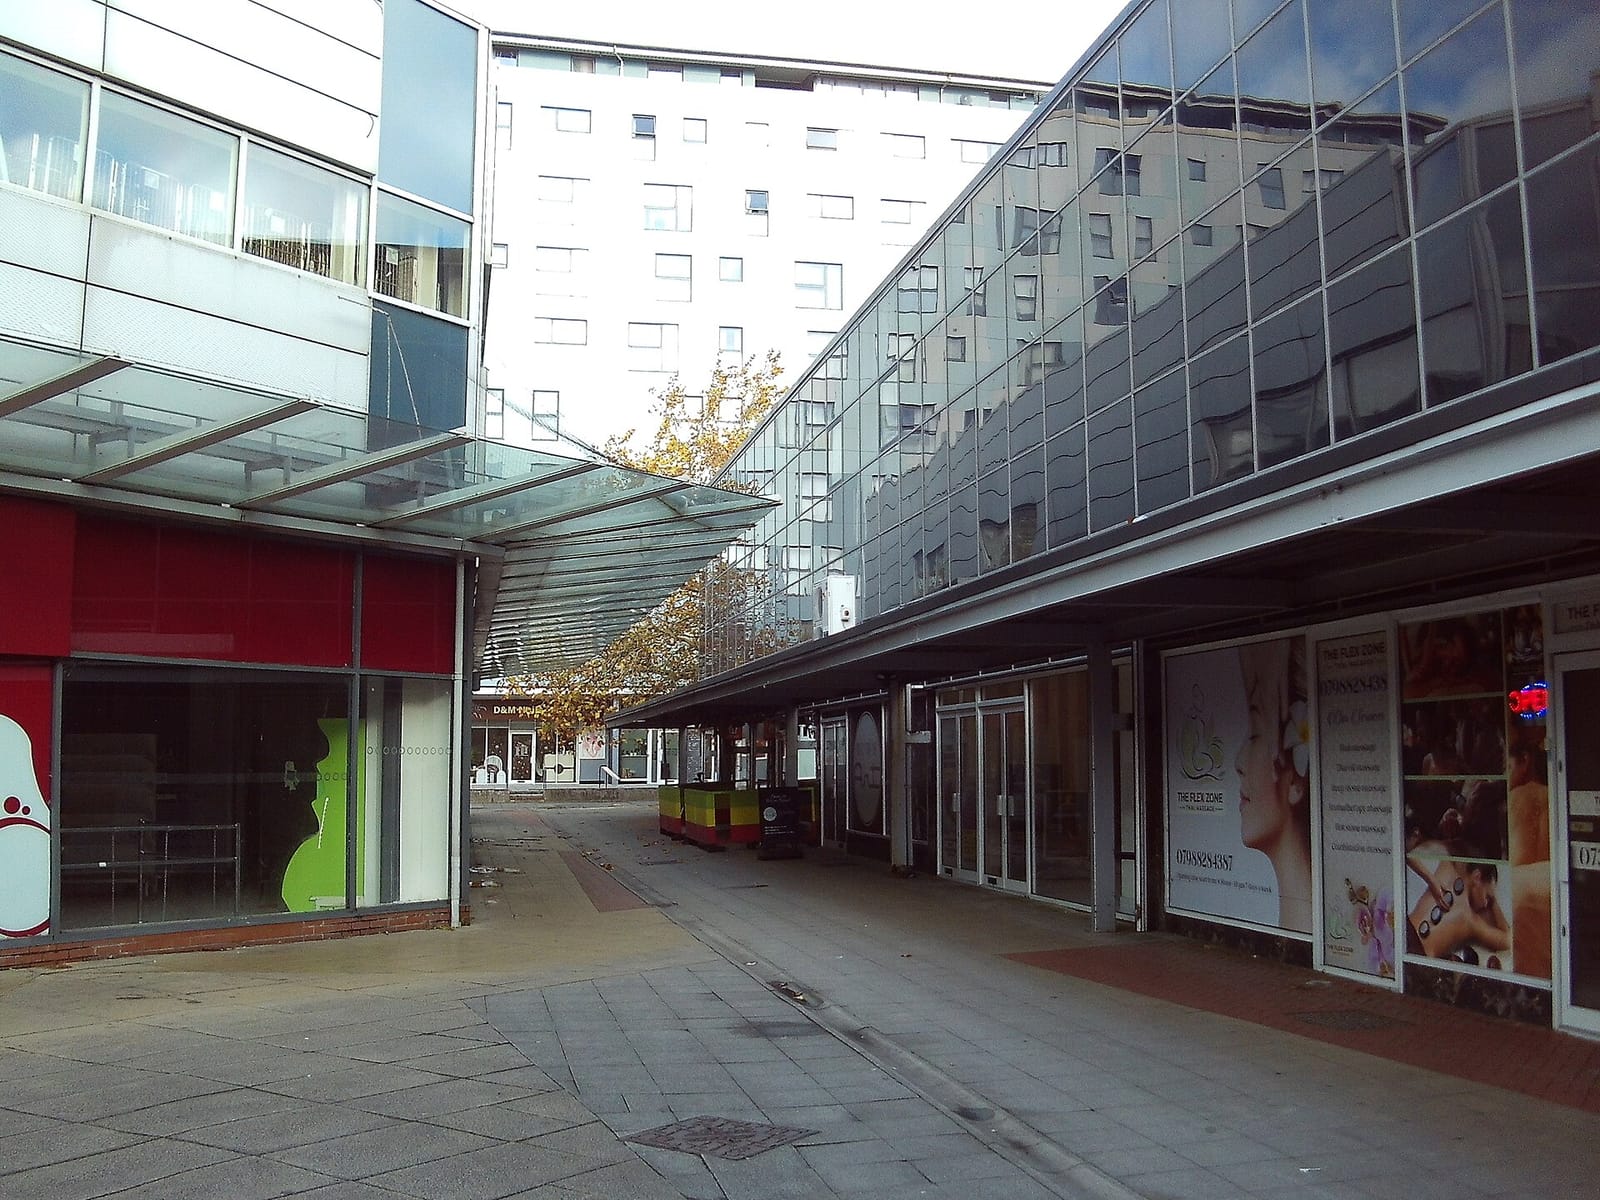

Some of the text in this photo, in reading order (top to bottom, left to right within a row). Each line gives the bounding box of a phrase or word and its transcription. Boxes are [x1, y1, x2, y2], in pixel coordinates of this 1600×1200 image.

[1568, 605, 1590, 620] THE
[493, 705, 516, 714] D&M
[1177, 791, 1224, 804] THE FLEX ZONE
[1176, 848, 1233, 871] 07988284387
